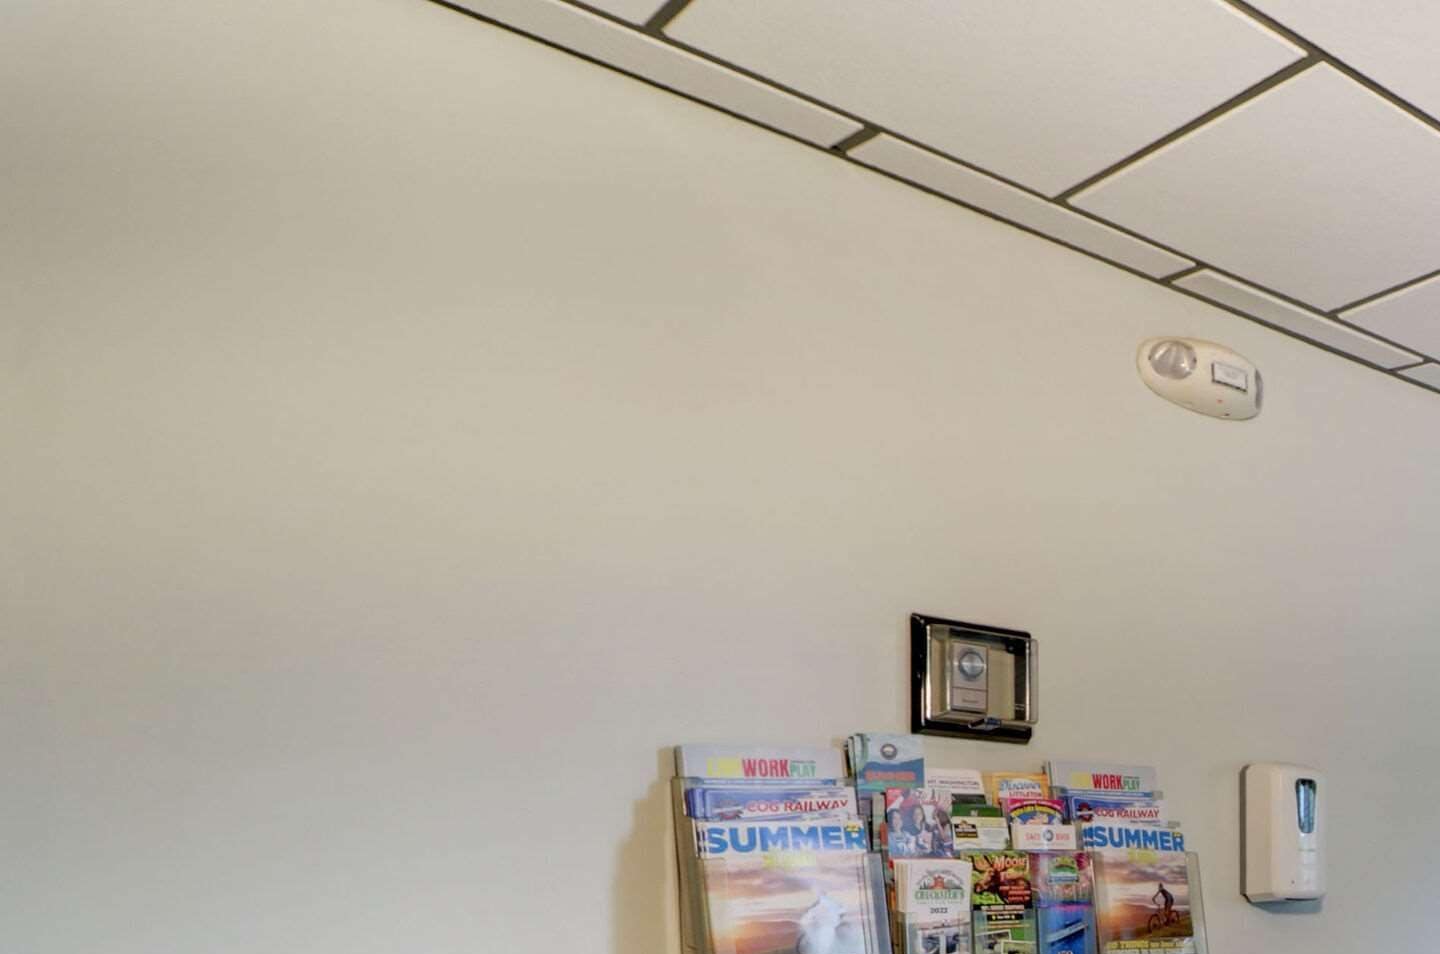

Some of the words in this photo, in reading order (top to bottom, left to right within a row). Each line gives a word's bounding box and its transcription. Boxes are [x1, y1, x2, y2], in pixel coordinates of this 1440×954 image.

[742, 759, 791, 777] WORK
[1092, 774, 1123, 791] WORK
[784, 800, 848, 813] RAILWAY
[1116, 807, 1160, 819] RAILWAY
[707, 824, 866, 856] SUMMER
[1094, 826, 1184, 851] SUMMER
